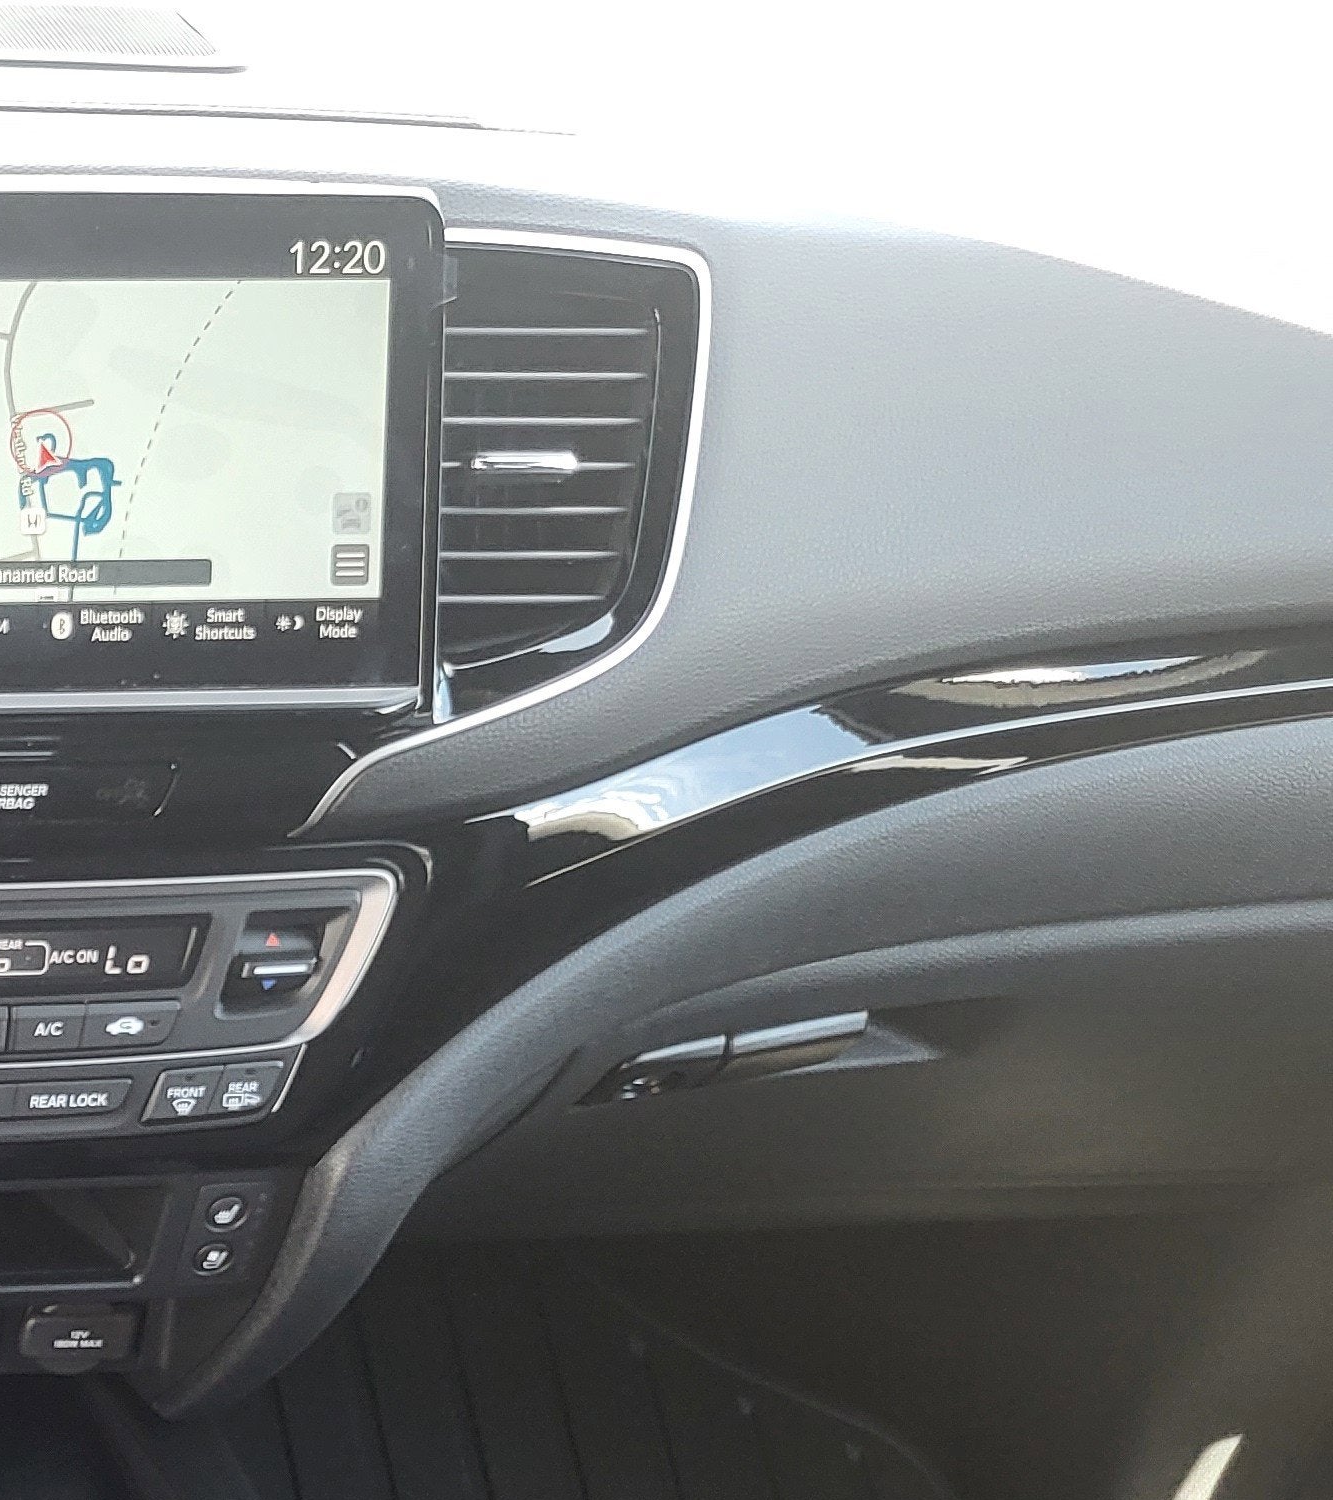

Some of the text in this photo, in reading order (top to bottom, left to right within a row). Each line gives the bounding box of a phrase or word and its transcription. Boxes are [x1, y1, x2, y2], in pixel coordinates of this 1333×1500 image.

[289, 239, 386, 274] 12:20
[58, 566, 99, 584] Road
[80, 609, 144, 626] Bluetooth
[206, 608, 244, 624] Smart
[316, 607, 363, 625] Display
[91, 626, 131, 642] Audio
[195, 624, 255, 641] Shortcuts
[319, 624, 357, 640] Mode
[76, 949, 100, 964] ON
[104, 945, 151, 974] Lo
[34, 1021, 64, 1038] A/C
[167, 1085, 206, 1100] FRONT
[228, 1081, 258, 1094] REAR
[29, 1092, 108, 1110] REAR LOCK
